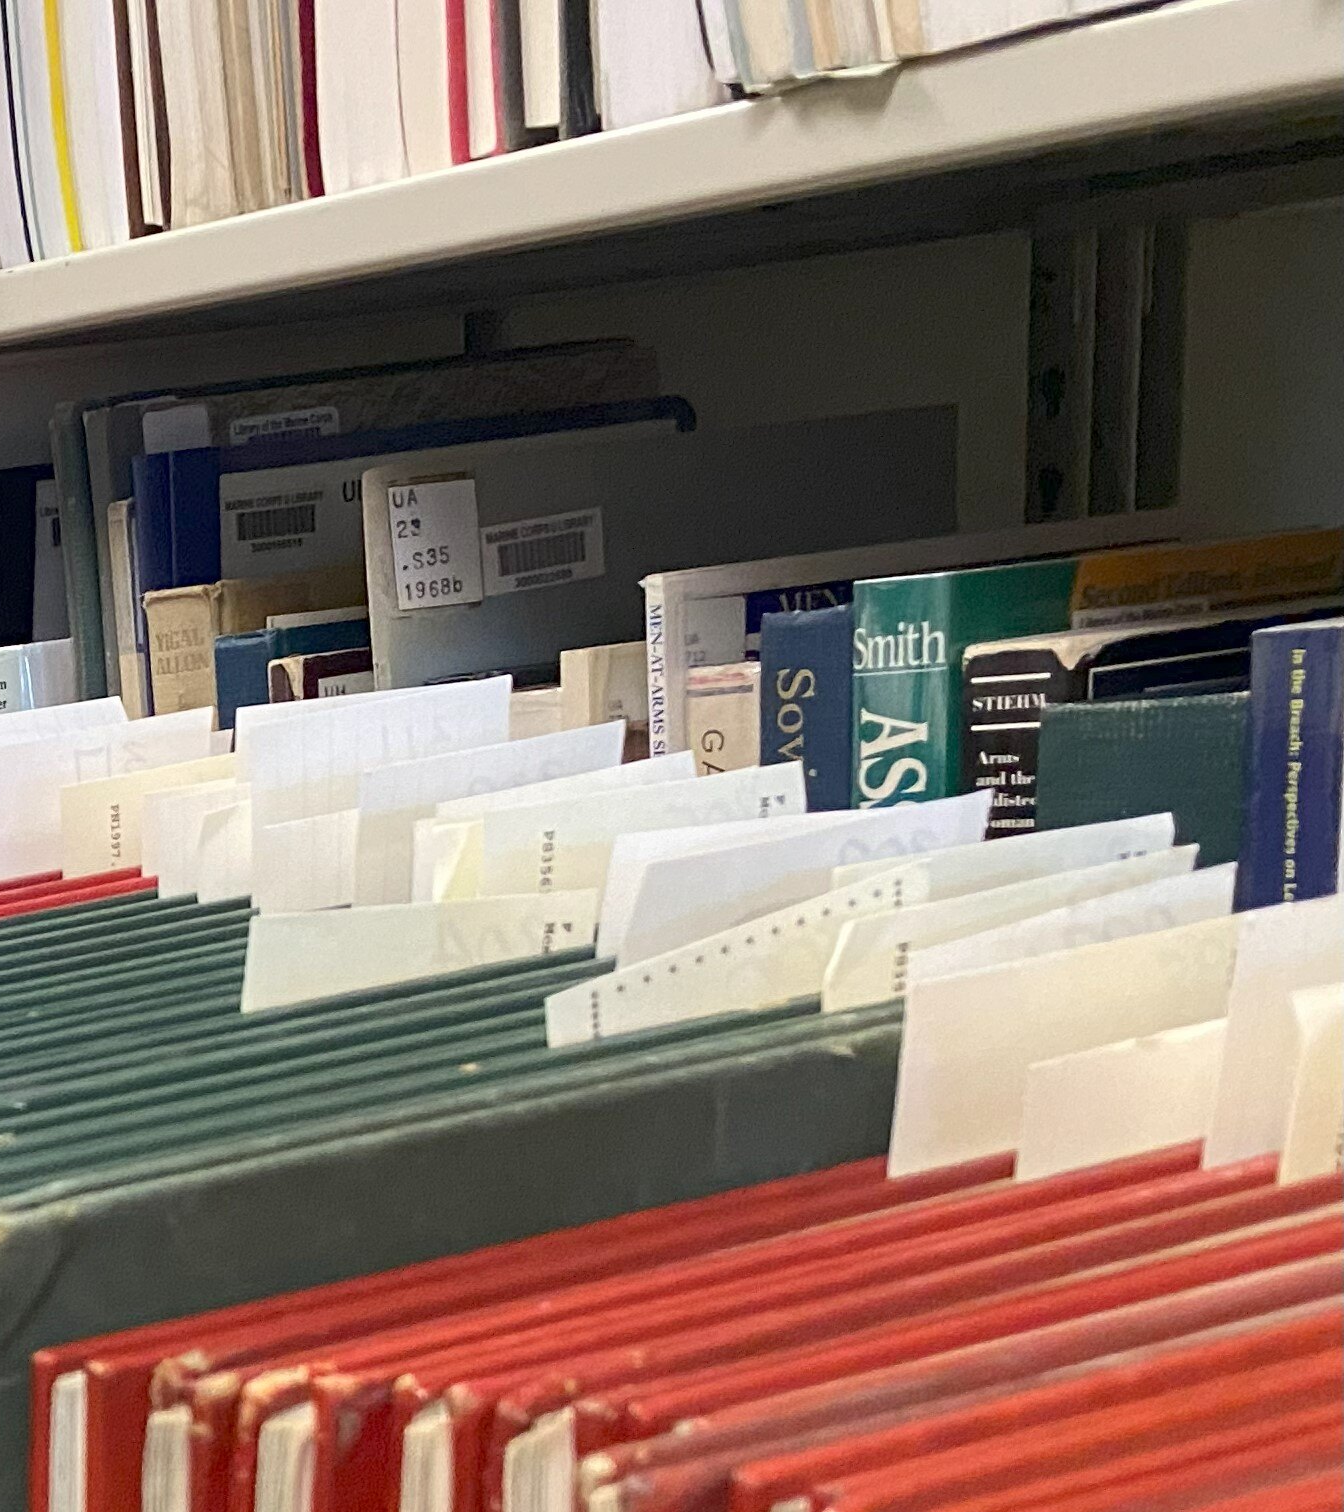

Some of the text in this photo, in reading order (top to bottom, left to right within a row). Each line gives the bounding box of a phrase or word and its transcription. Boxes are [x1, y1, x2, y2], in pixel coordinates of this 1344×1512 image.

[392, 489, 418, 509] UA
[405, 575, 463, 601] 1968b
[853, 621, 946, 671] Smith
[1291, 648, 1306, 664] In
[648, 604, 665, 736] MEN-AT-ARMS
[1290, 668, 1305, 694] the
[972, 693, 1047, 712] STIEHM
[978, 751, 1020, 765] Arms
[976, 771, 1006, 786] and
[1283, 761, 1301, 855] Perspectives
[1283, 858, 1296, 879] on
